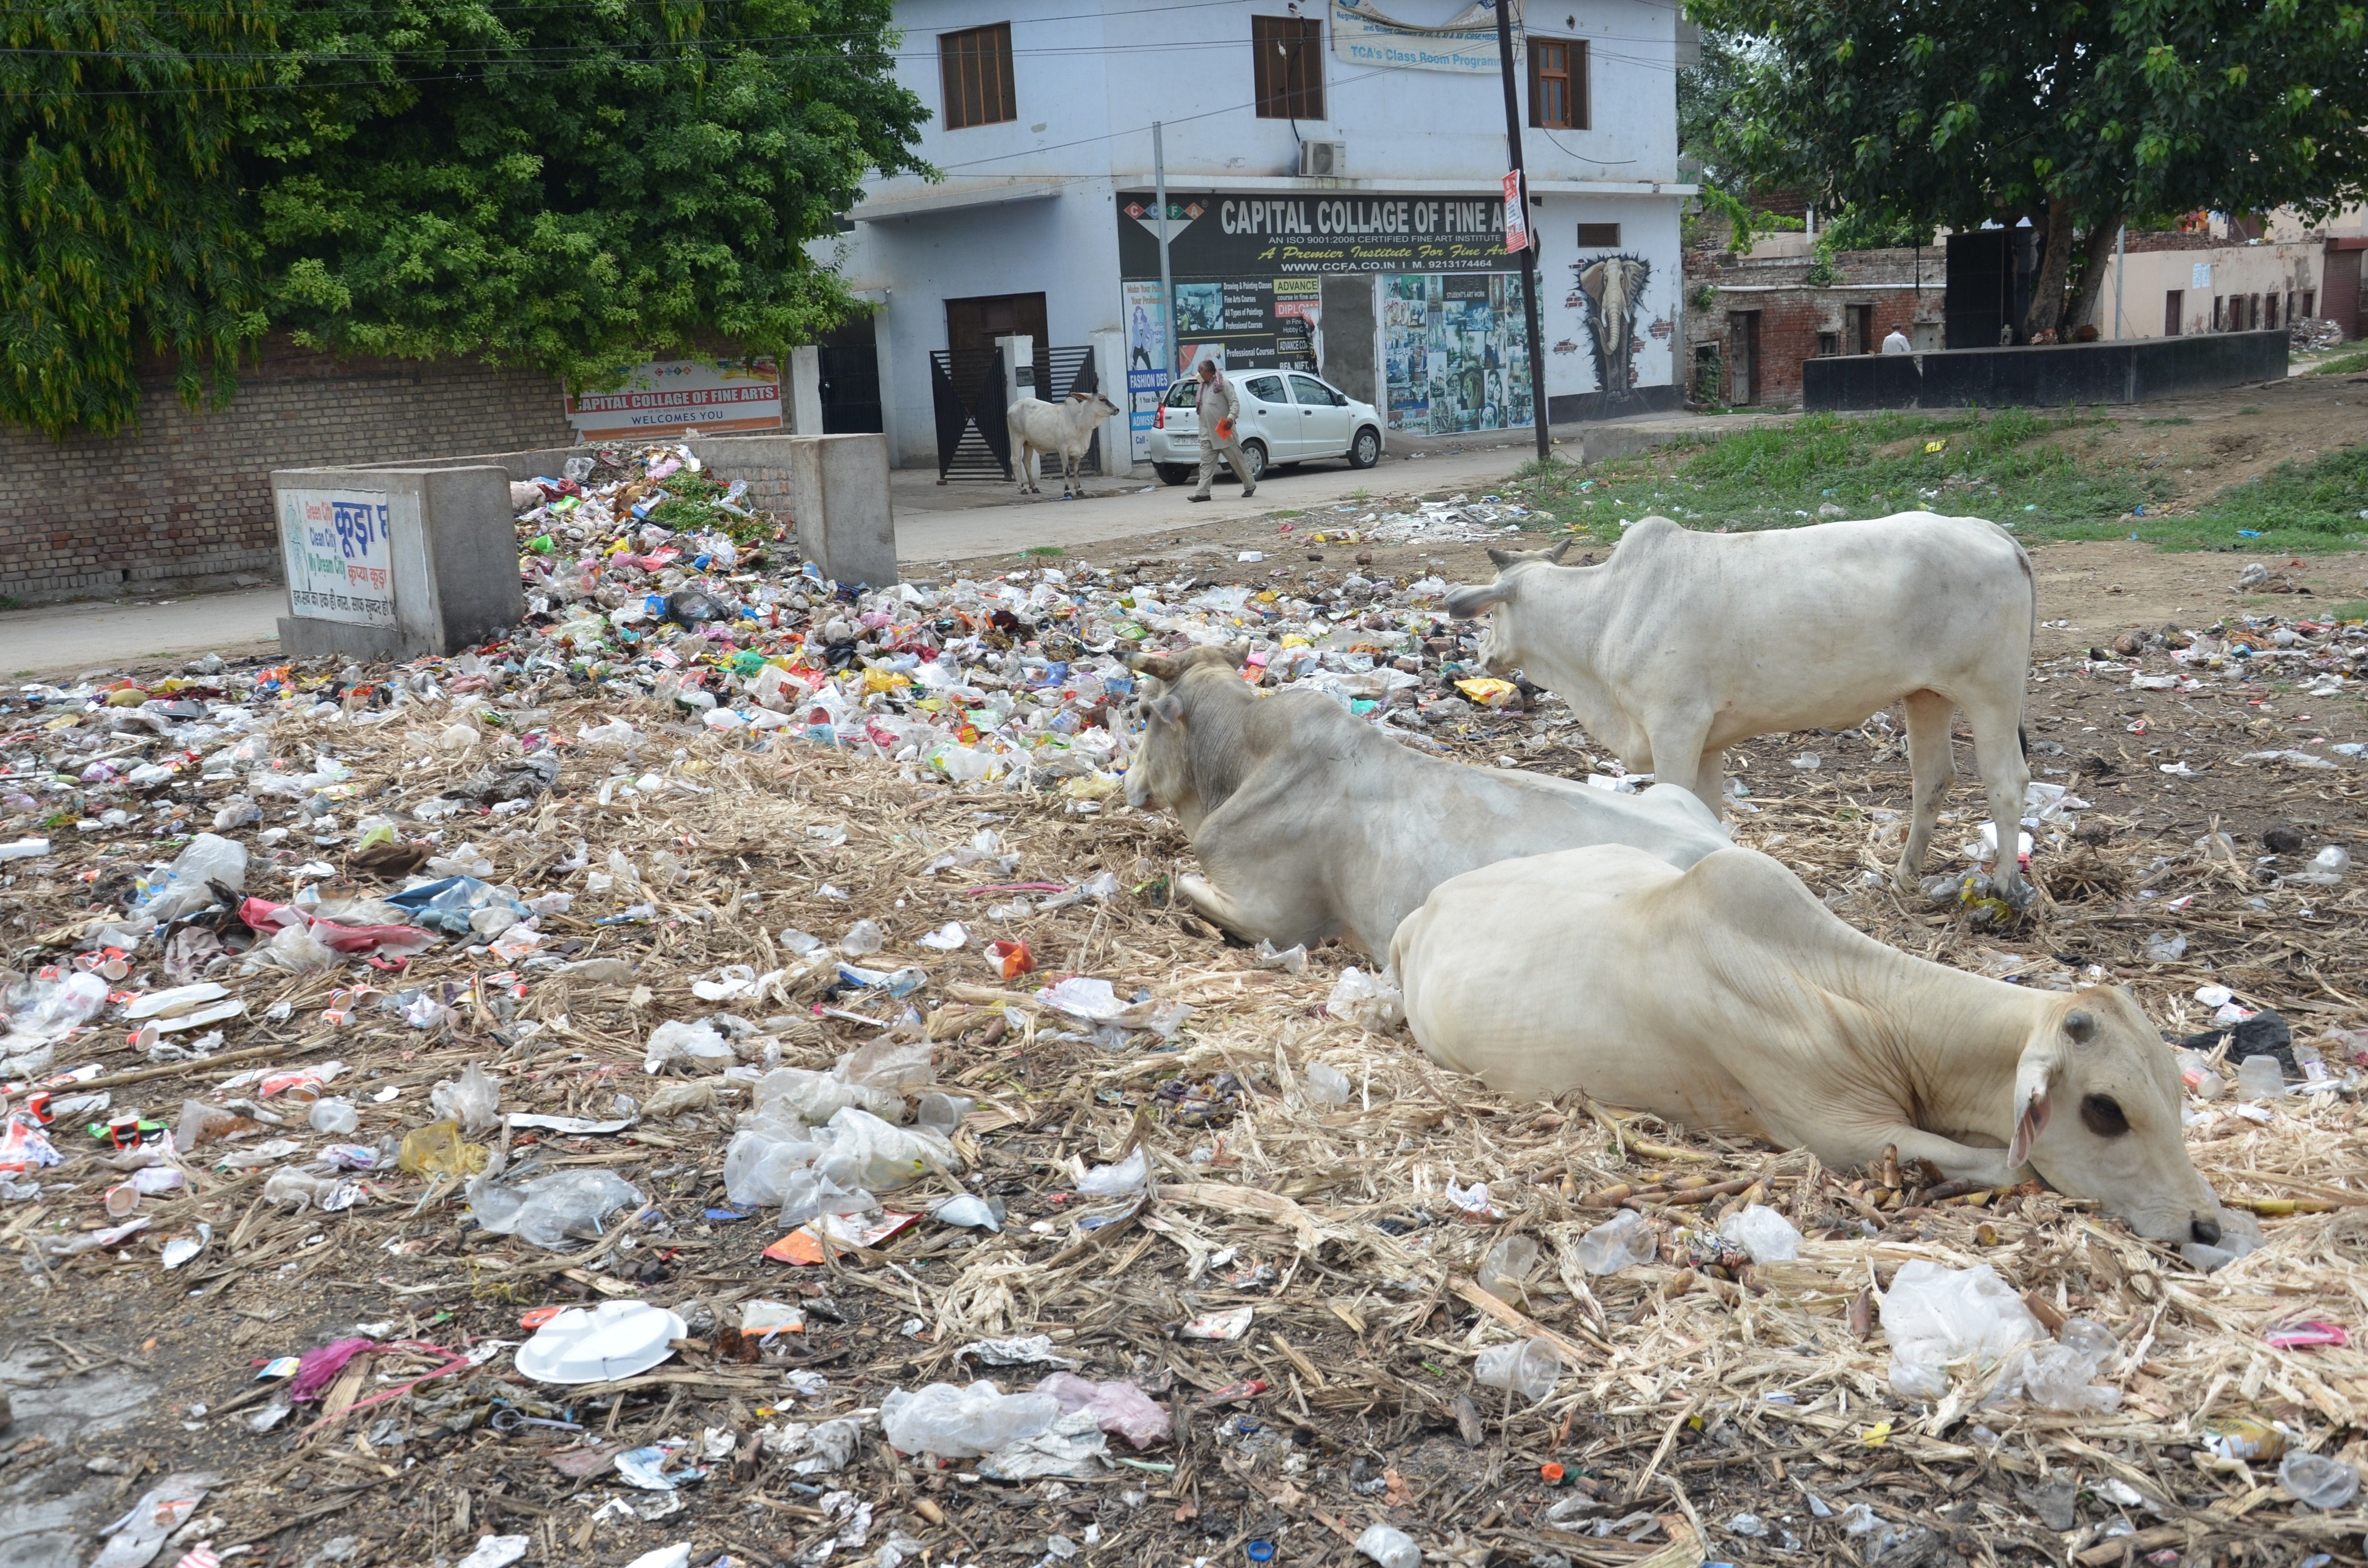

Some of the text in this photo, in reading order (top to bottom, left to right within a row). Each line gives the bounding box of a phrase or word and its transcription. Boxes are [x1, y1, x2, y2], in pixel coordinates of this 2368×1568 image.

[1337, 12, 1361, 22] Regular
[1351, 46, 1382, 59] TCA's
[1386, 49, 1417, 62] Class
[1419, 52, 1449, 65] Room
[1221, 200, 1311, 234] CAPITAL
[1317, 201, 1409, 234] COLLAGE
[1415, 201, 1439, 233] OF
[1444, 202, 1486, 233] FINE
[1258, 247, 1276, 260] A
[1283, 246, 1344, 260] Premier
[1350, 245, 1412, 258] Institute
[1418, 245, 1443, 258] For
[1450, 245, 1482, 257] Fine
[1281, 261, 1395, 272] WWW.CCFA.CO.IN
[1429, 260, 1492, 269] 9213174464
[1223, 282, 1239, 291] Drawing
[1243, 282, 1258, 291] Painting
[1277, 281, 1318, 291] ADVANCE
[1231, 309, 1242, 318] Types
[1246, 308, 1263, 317] Paintings
[1280, 341, 1298, 351] ADVANCE
[1226, 347, 1275, 357] Professional Courses
[1249, 359, 1254, 368] in
[1295, 361, 1309, 371] NIFT,
[1130, 372, 1167, 389] FASHION DES
[631, 391, 690, 408] COLLAGE
[692, 389, 708, 403] OF
[711, 387, 739, 402] FINE
[741, 386, 774, 400] ARTS
[631, 411, 723, 425] WELCOMES YOU
[1136, 436, 1145, 444] Call
[325, 528, 336, 553] City
[334, 554, 345, 580] City
